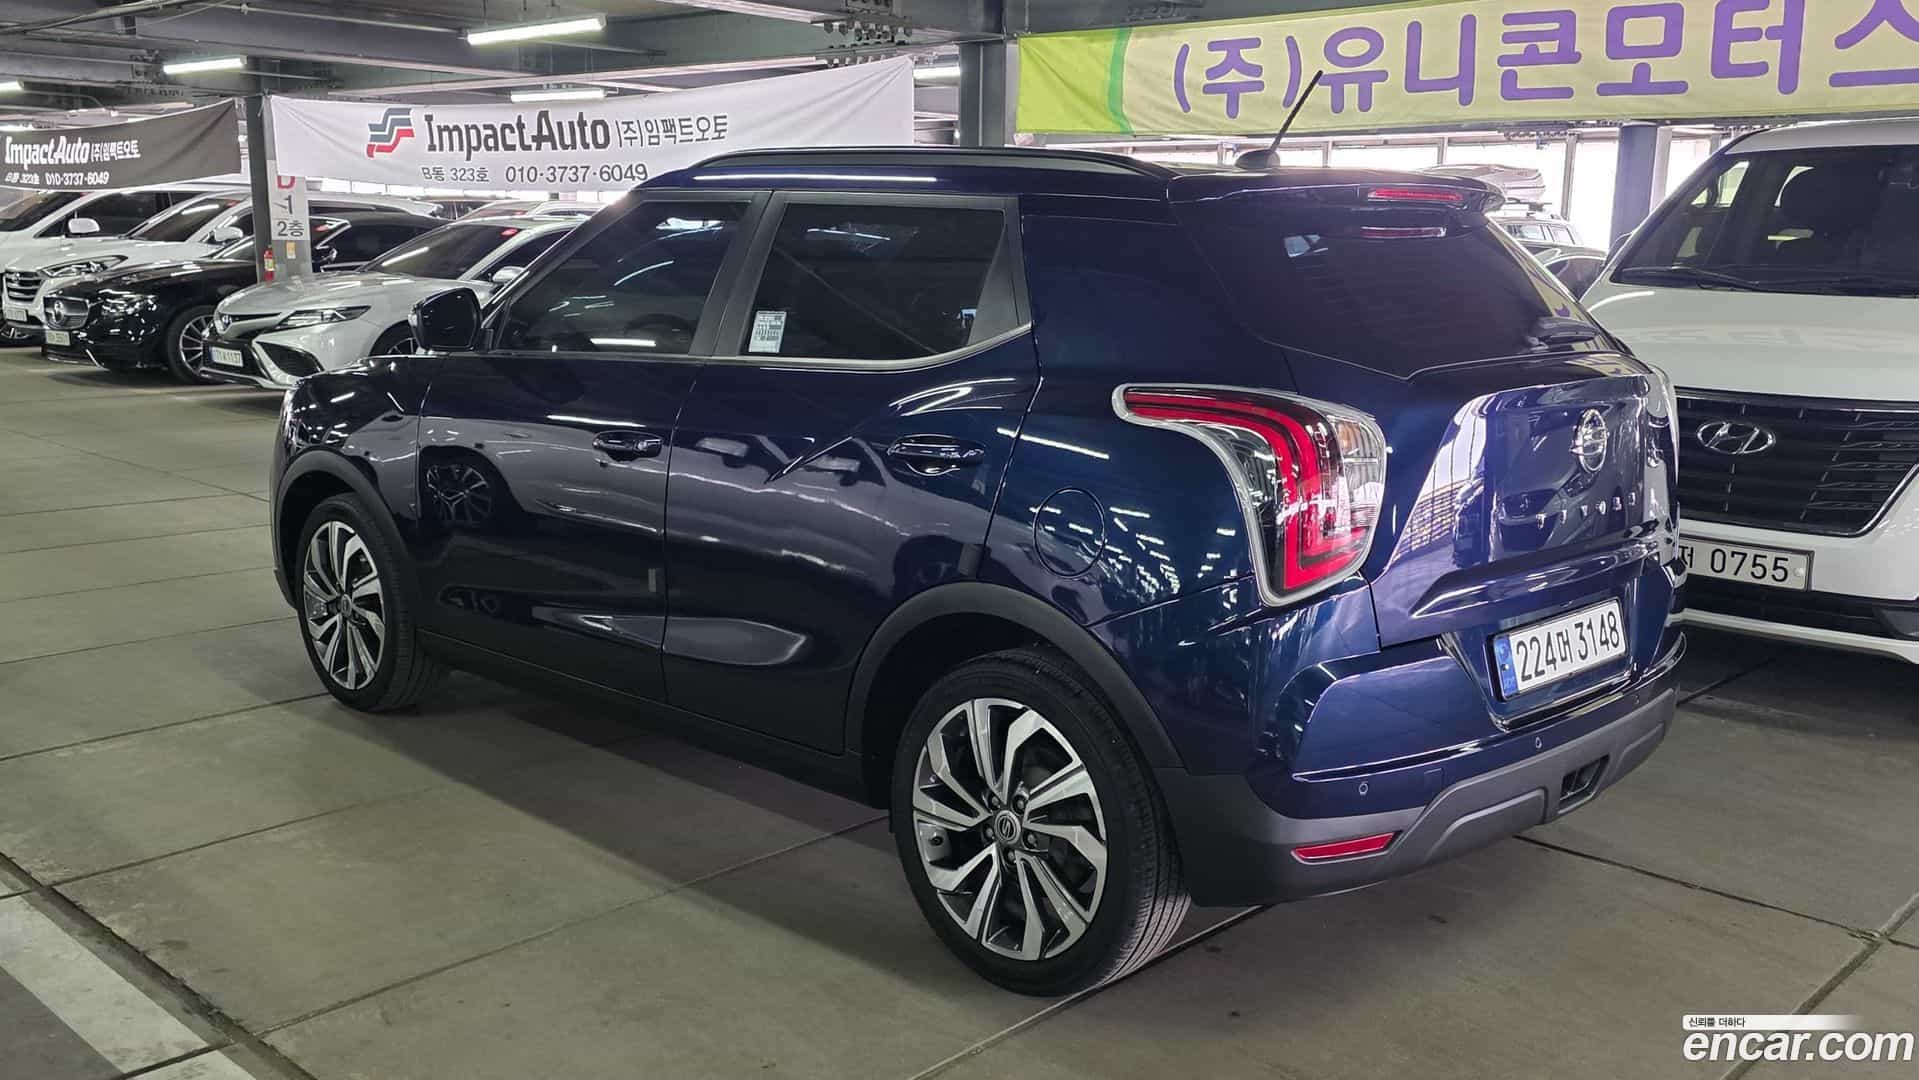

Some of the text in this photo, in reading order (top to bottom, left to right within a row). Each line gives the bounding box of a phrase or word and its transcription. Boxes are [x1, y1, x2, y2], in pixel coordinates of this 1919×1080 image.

[421, 167, 446, 183] B동
[449, 167, 490, 183] 323호
[276, 219, 305, 237] 2층
[1709, 547, 1790, 583] 0755
[1515, 610, 1621, 682] 224머 3148
